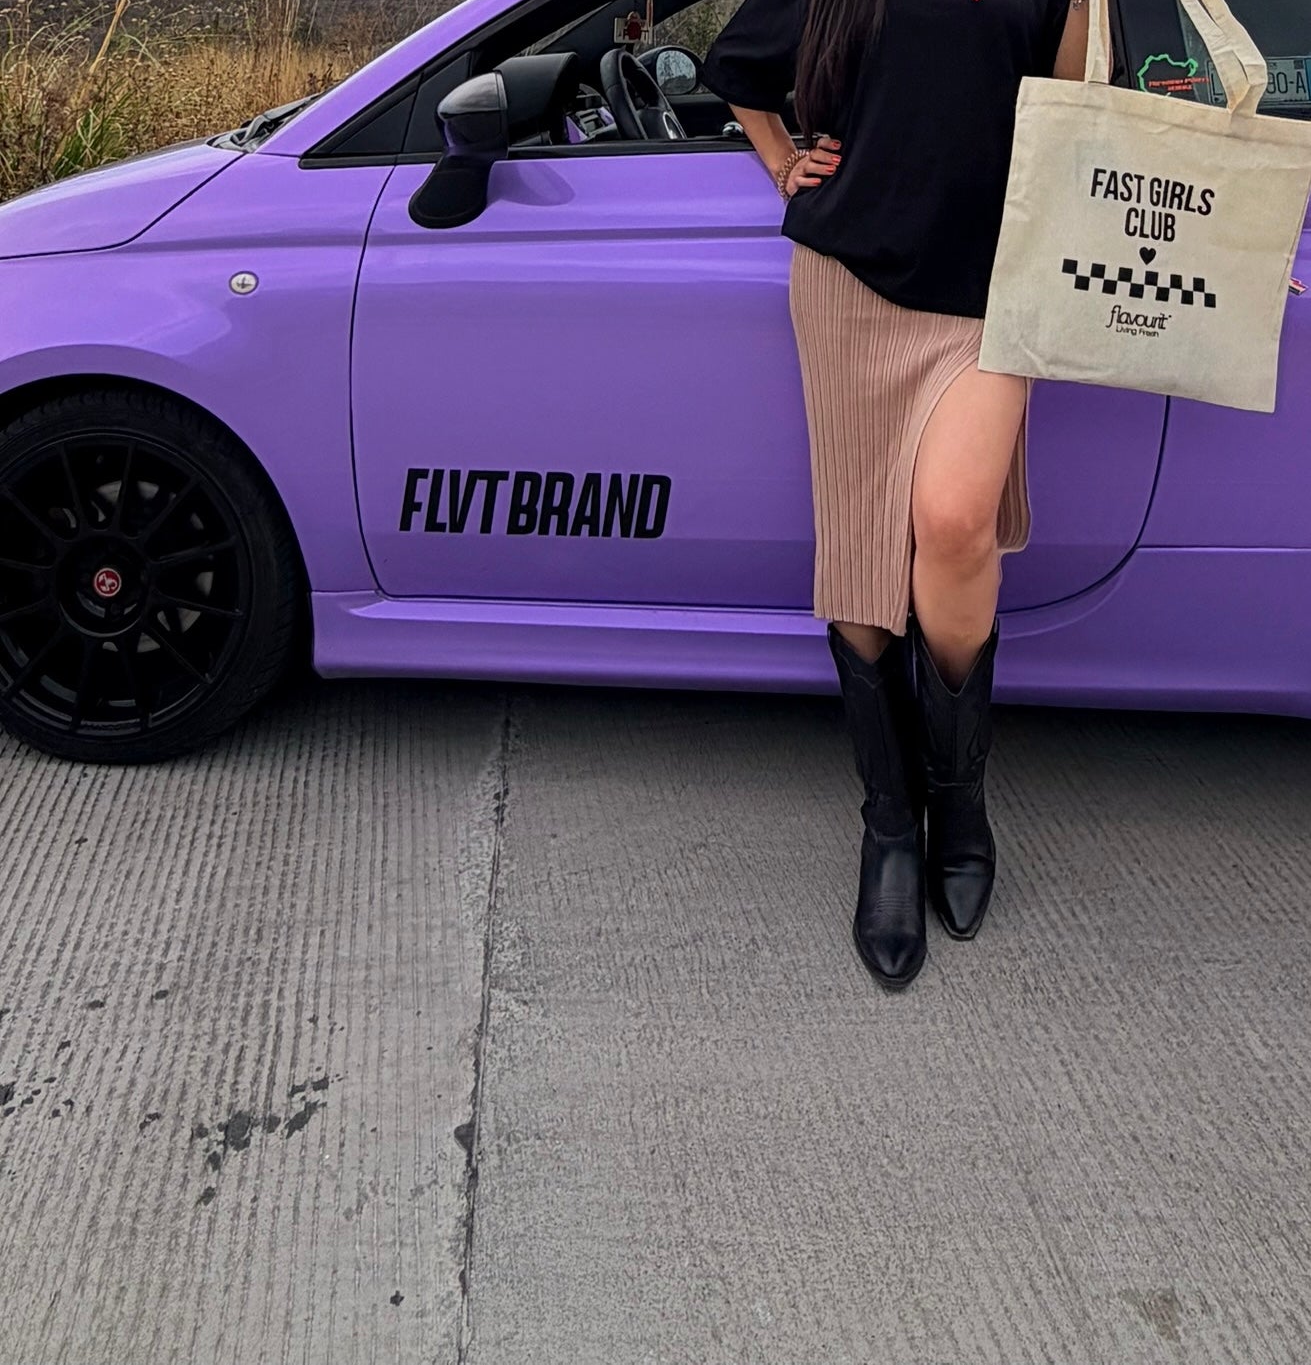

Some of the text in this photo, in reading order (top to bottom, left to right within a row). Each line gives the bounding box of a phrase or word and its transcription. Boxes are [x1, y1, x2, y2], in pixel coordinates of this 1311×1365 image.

[1090, 168, 1215, 216] FAST GIRLS
[1124, 207, 1176, 242] CLUB
[399, 468, 672, 539] FLVT BRAND
